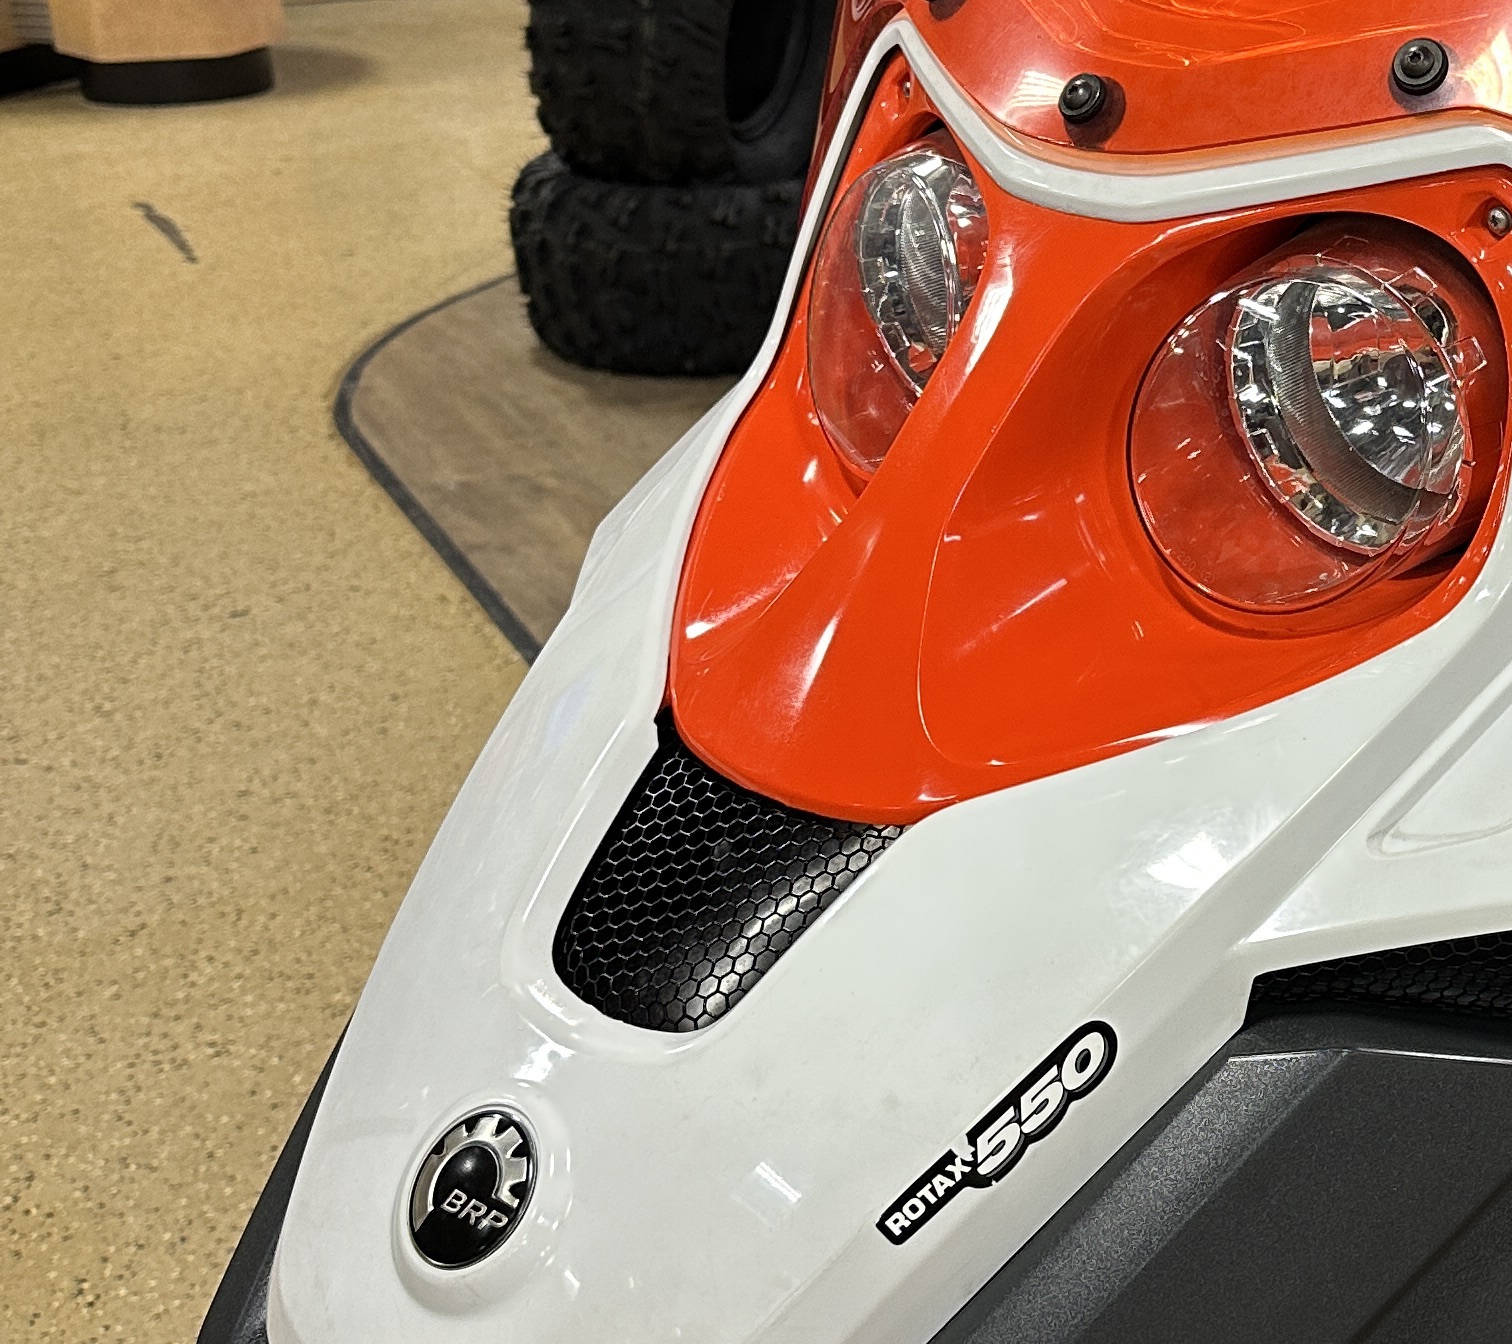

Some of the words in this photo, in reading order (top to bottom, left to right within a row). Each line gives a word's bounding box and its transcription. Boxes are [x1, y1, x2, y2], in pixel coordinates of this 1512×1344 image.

[885, 1156, 972, 1236] ROTAX
[977, 1032, 1107, 1176] 550
[440, 1189, 508, 1229] BRP
